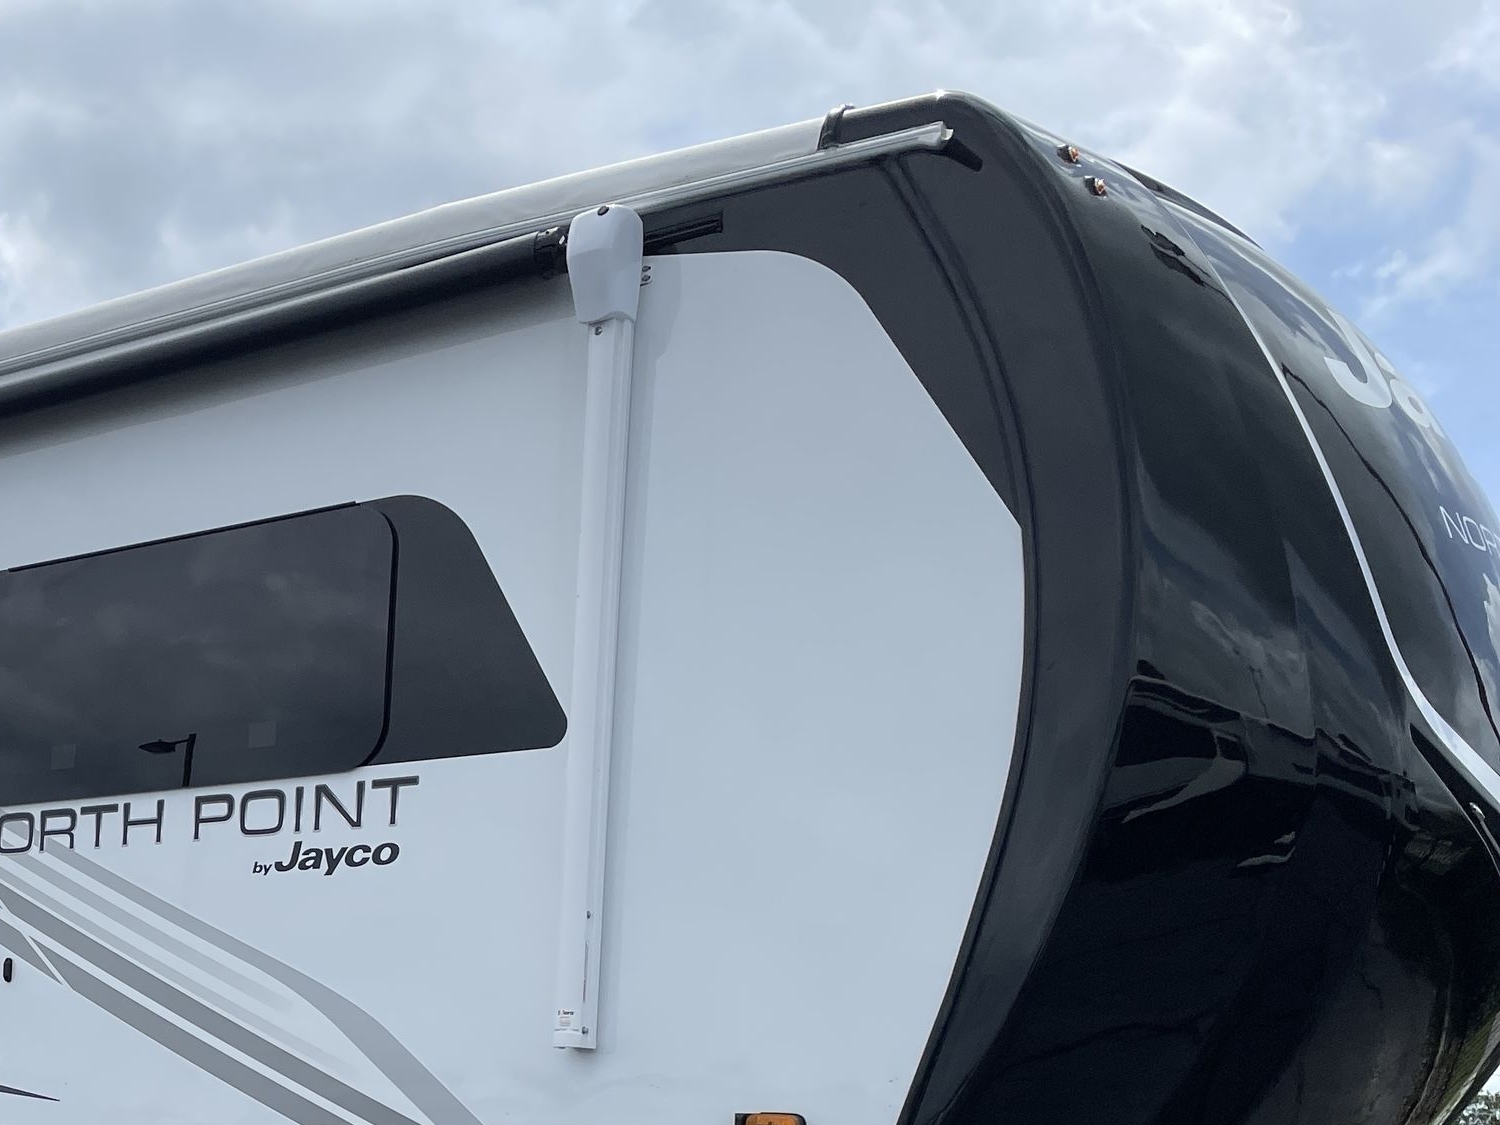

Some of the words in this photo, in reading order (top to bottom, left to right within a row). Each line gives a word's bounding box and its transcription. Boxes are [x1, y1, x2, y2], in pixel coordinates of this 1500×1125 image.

[193, 775, 420, 842] POINT
[252, 861, 272, 876] by
[274, 841, 400, 876] Jayco
